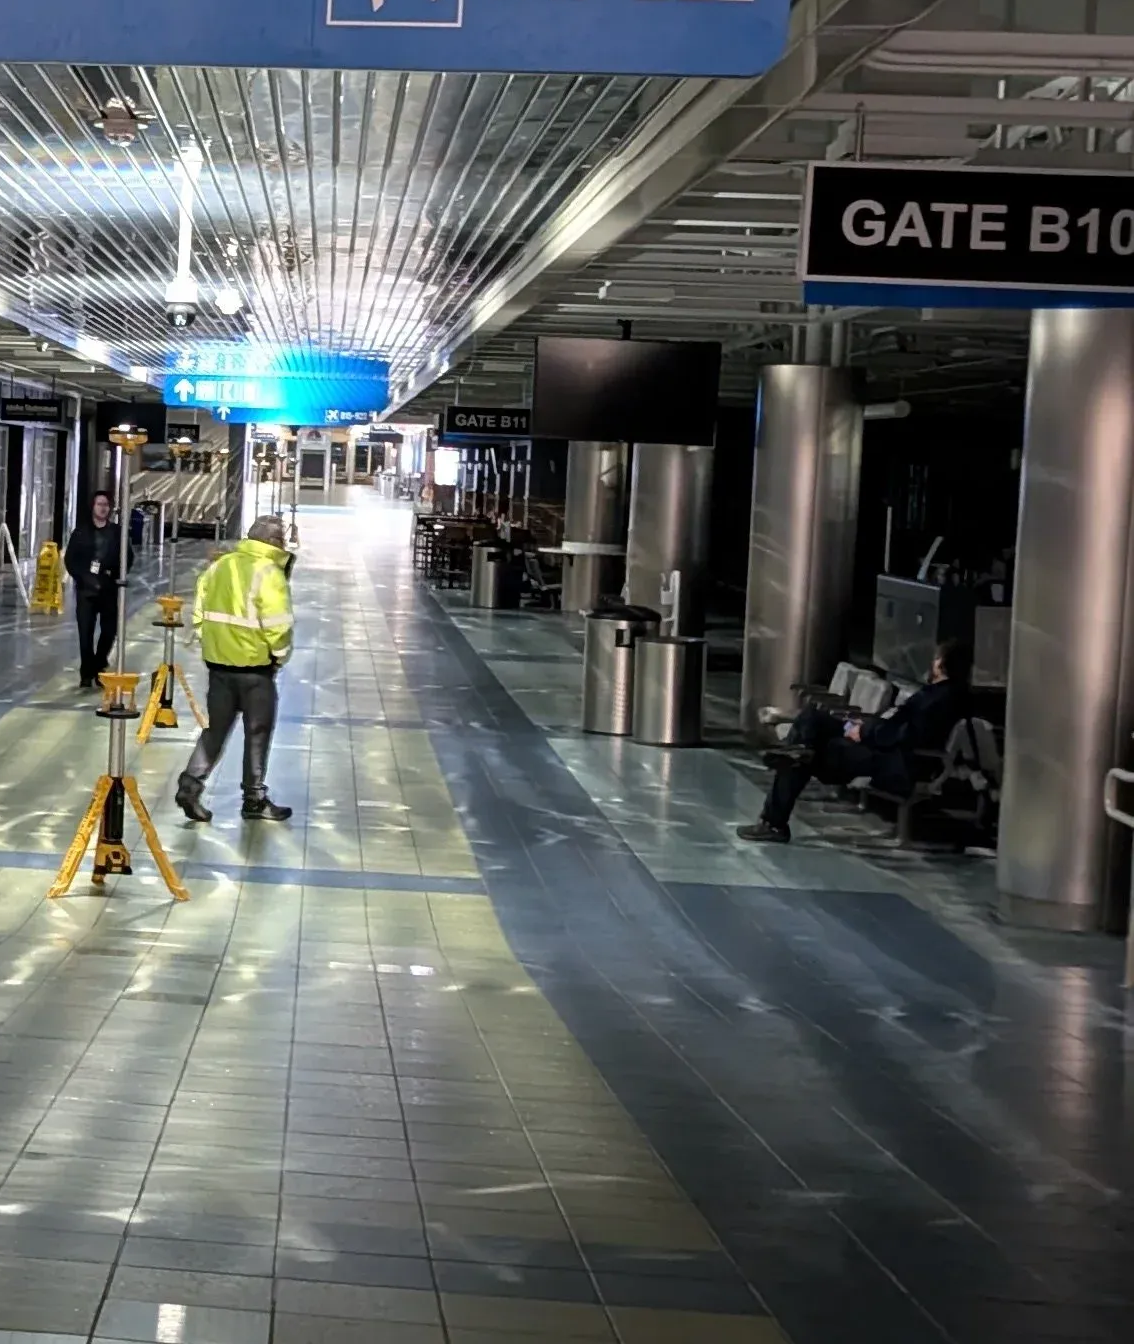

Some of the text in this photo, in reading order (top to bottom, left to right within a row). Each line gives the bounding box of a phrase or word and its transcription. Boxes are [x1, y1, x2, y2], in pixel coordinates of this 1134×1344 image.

[841, 198, 1134, 256] GATE B10
[455, 413, 527, 429] GATE B11
